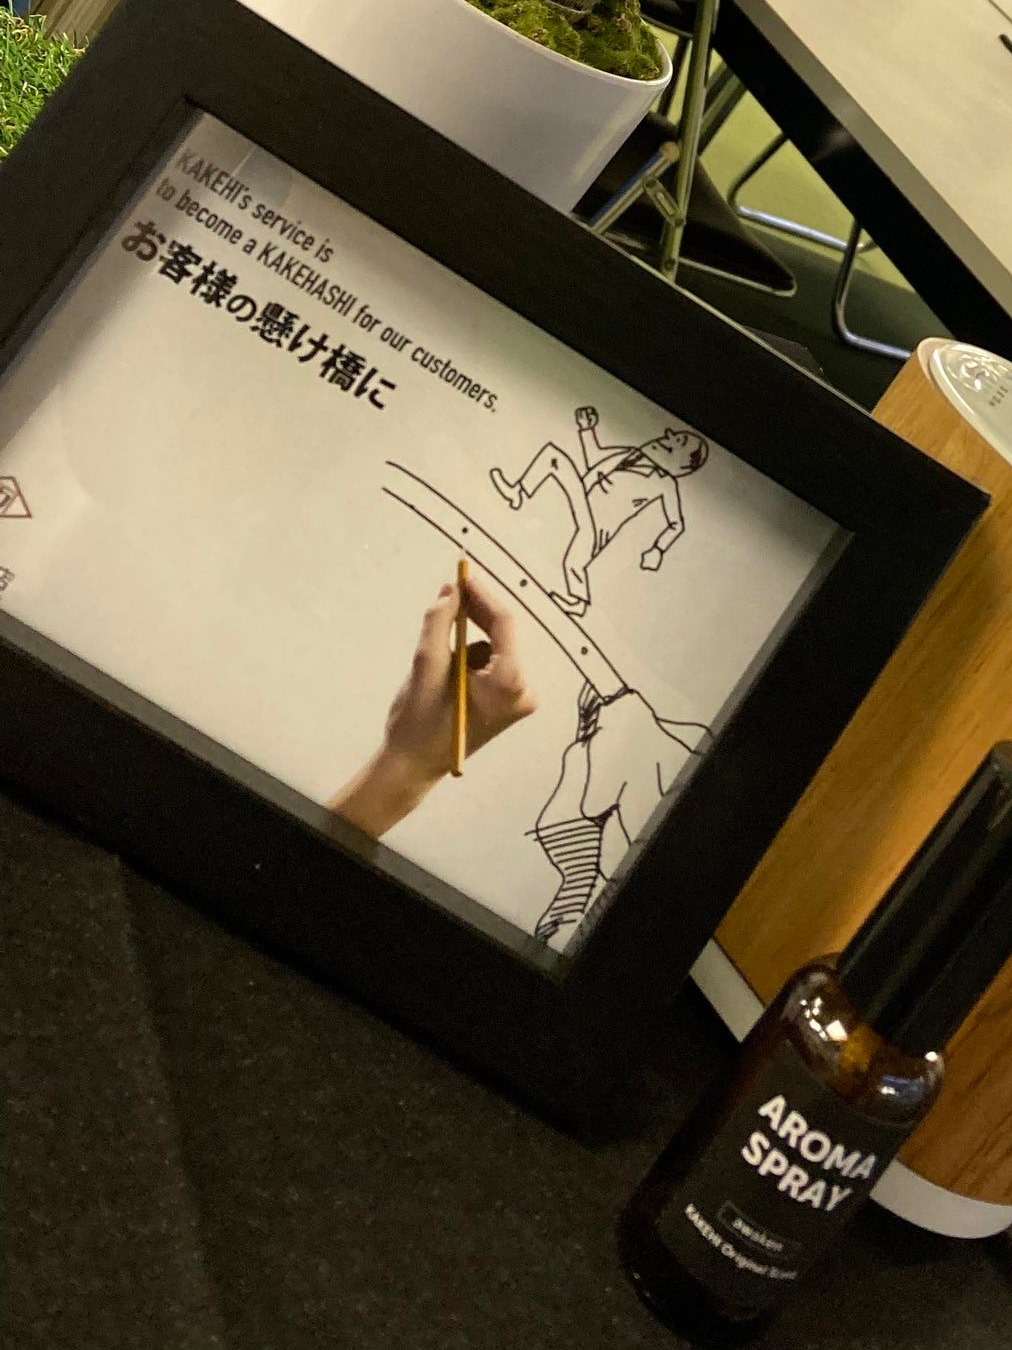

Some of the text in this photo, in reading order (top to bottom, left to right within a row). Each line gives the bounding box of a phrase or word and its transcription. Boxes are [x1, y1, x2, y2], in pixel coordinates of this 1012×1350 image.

[176, 149, 334, 263] KAKEHI's service is
[121, 219, 397, 411] お客様の懸け橋に
[156, 177, 498, 413] to become a KAKEHASHI for our customers.
[741, 1131, 854, 1211] SPRAY
[758, 1094, 877, 1179] AROMA
